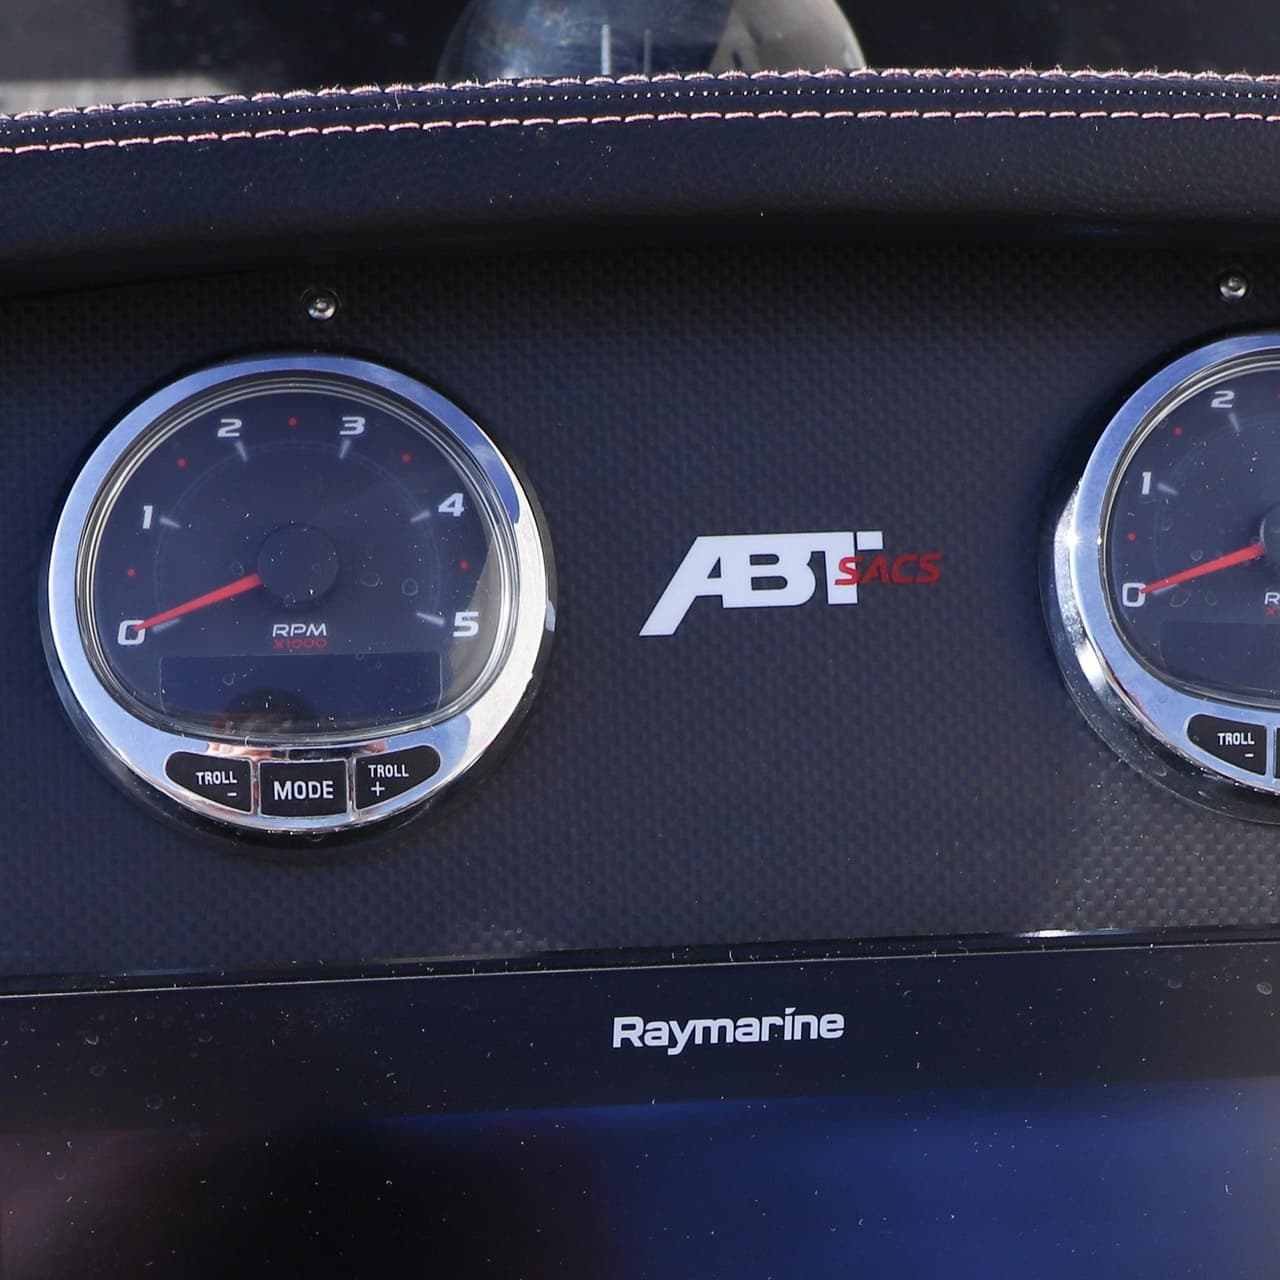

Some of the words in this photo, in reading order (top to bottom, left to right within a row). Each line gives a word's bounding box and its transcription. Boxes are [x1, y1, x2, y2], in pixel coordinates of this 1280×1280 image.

[1211, 391, 1235, 409] 2
[217, 417, 243, 438] 2
[340, 415, 366, 436] 3
[1141, 471, 1153, 495] 1
[438, 492, 464, 517] 4
[143, 505, 153, 529] 1
[834, 552, 944, 586] SACS
[639, 531, 883, 638] ABT
[1122, 582, 1147, 608] 0
[117, 619, 146, 646] 0
[272, 623, 327, 637] RPM
[452, 611, 479, 637] 5
[1218, 732, 1255, 747] TROLL
[196, 769, 238, 786] TROLL
[368, 762, 409, 778] TROLL
[273, 780, 334, 801] MODE
[613, 1007, 845, 1055] Raymarine
